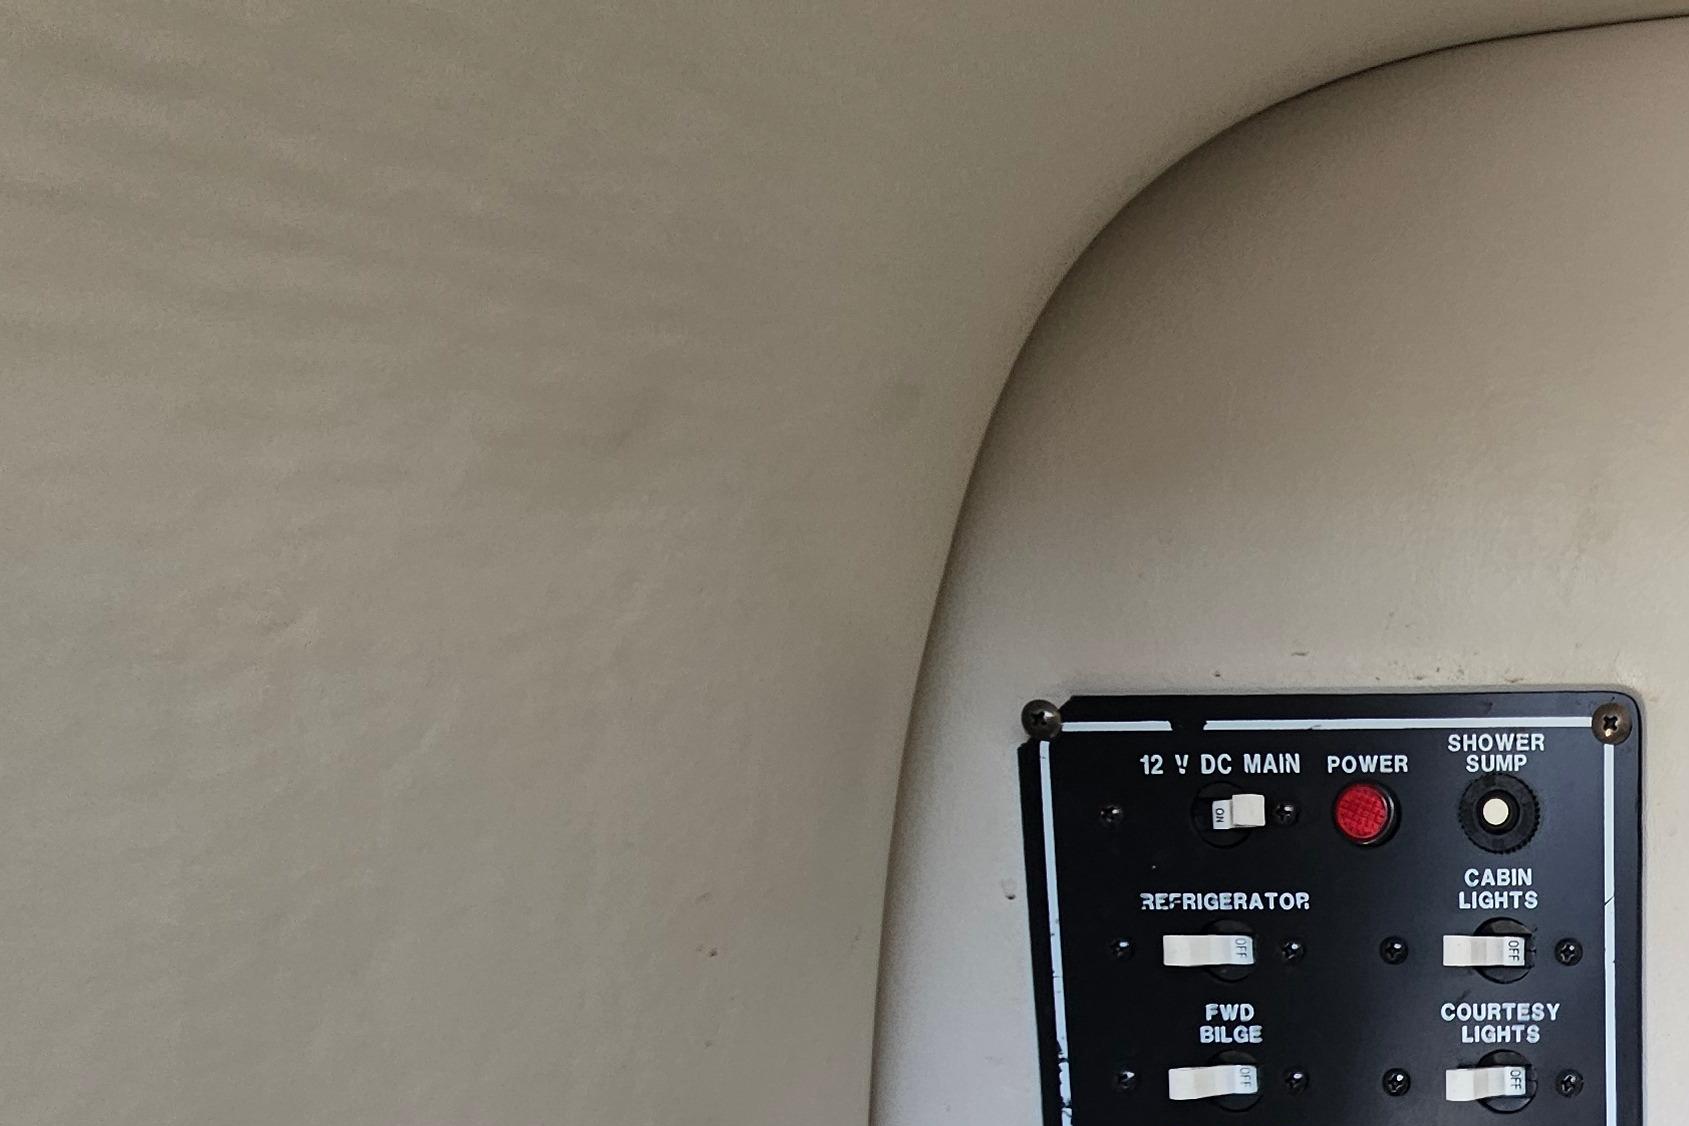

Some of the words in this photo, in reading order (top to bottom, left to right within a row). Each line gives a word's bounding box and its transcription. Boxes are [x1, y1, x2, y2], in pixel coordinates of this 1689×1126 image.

[1448, 733, 1546, 753] SHOWER
[1140, 755, 1164, 775] 12
[1175, 754, 1189, 774] V
[1201, 754, 1232, 774] DC
[1244, 753, 1300, 774] MAIN
[1328, 755, 1408, 773] POWER
[1465, 752, 1527, 773] SUMP
[1215, 807, 1224, 823] ON
[1464, 868, 1532, 886] CABIN
[1140, 892, 1310, 910] REFRIGERATOR
[1459, 891, 1538, 910] LIGHTS
[1235, 938, 1247, 960] OFF
[1508, 940, 1520, 962] OFF
[1206, 1004, 1254, 1021] FWD
[1441, 1003, 1560, 1022] COURTESY
[1200, 1025, 1263, 1043] BILGE
[1461, 1025, 1540, 1044] LIGHTS
[1239, 1067, 1251, 1088] OFF
[1509, 1069, 1522, 1091] OFF
